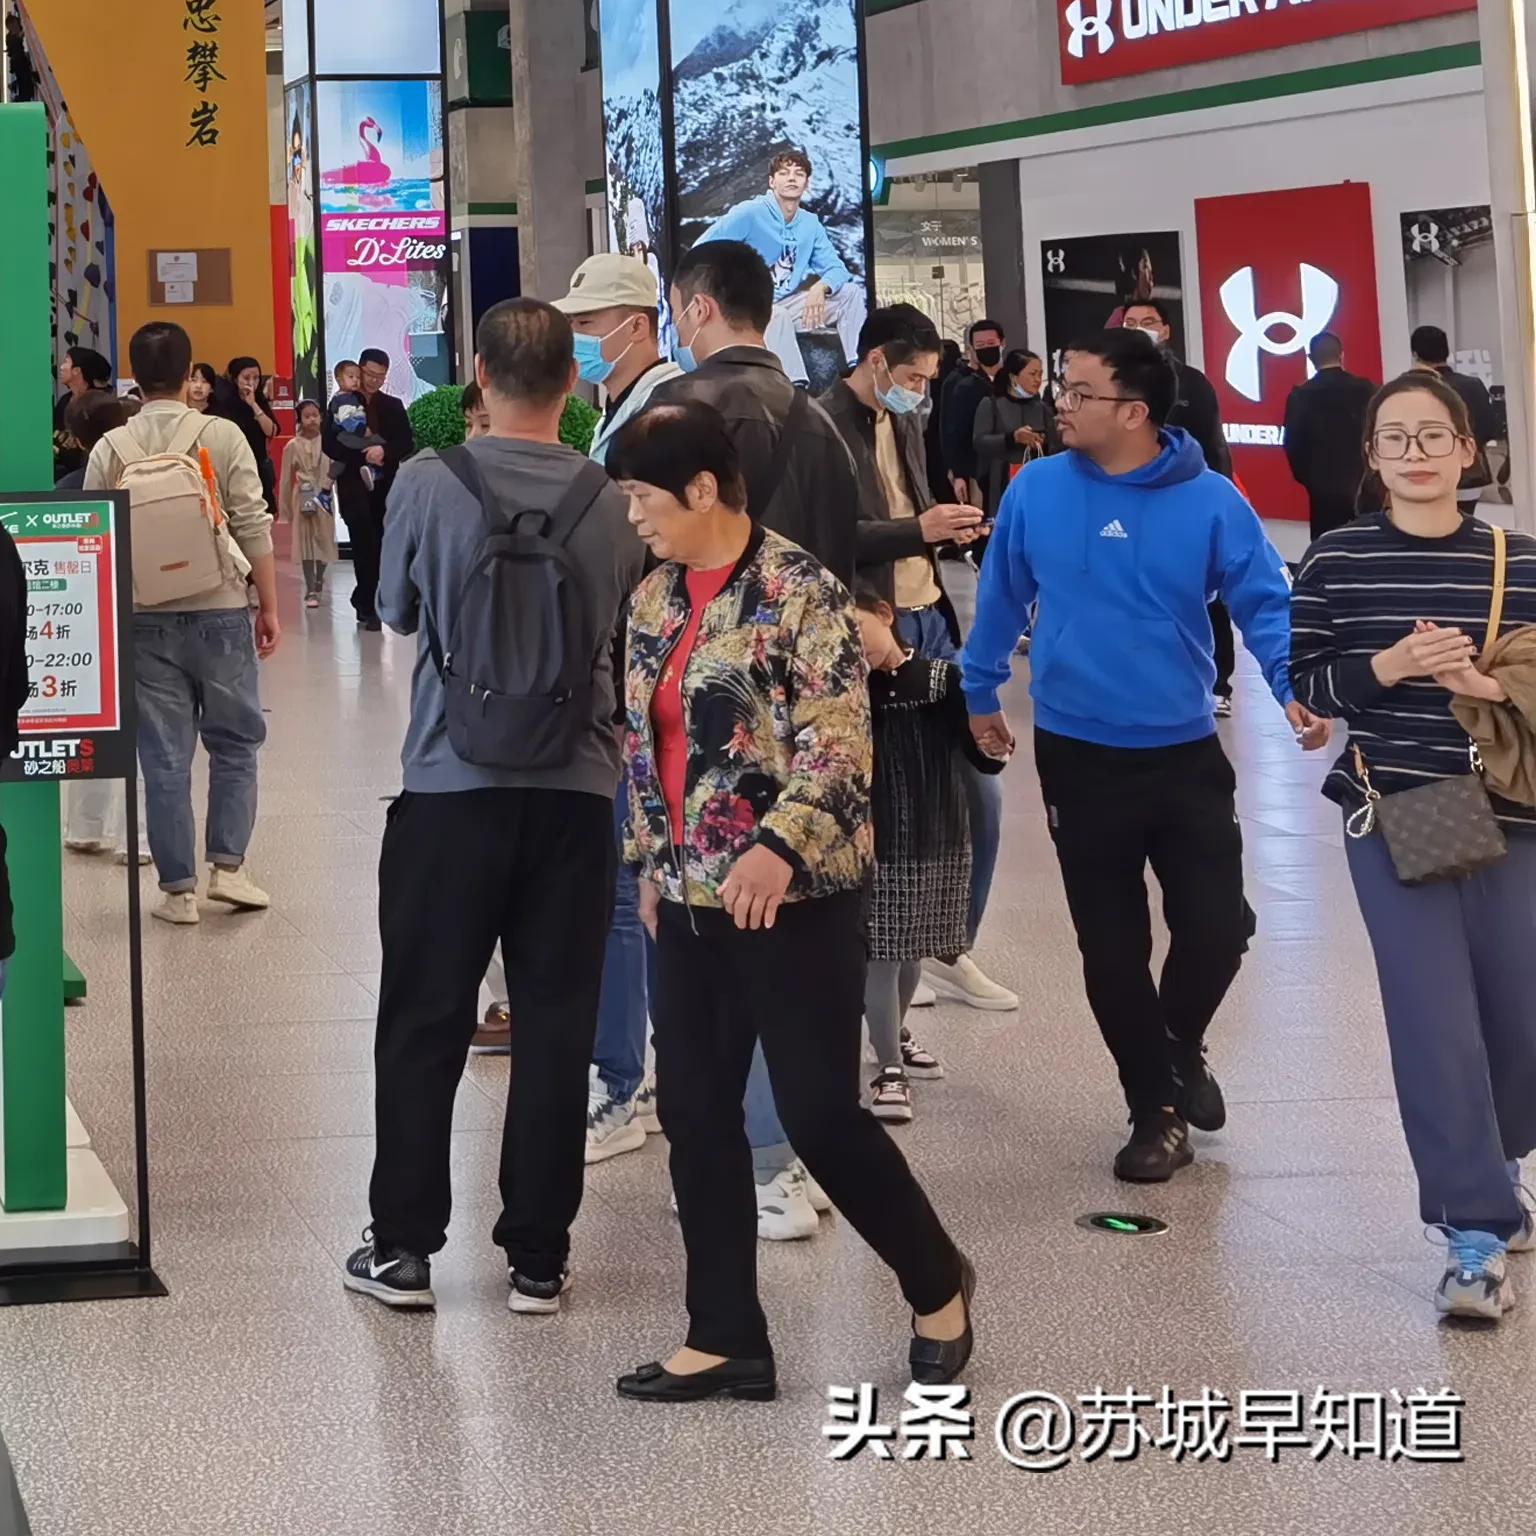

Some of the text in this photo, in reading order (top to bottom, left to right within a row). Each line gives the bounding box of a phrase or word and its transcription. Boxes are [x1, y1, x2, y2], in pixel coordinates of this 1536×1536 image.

[325, 216, 441, 232] SKECHERS
[346, 237, 447, 266] D'Lites
[921, 236, 979, 246] WOMEN'S
[1222, 423, 1279, 445] UNDER
[10, 738, 96, 759] UTLETS
